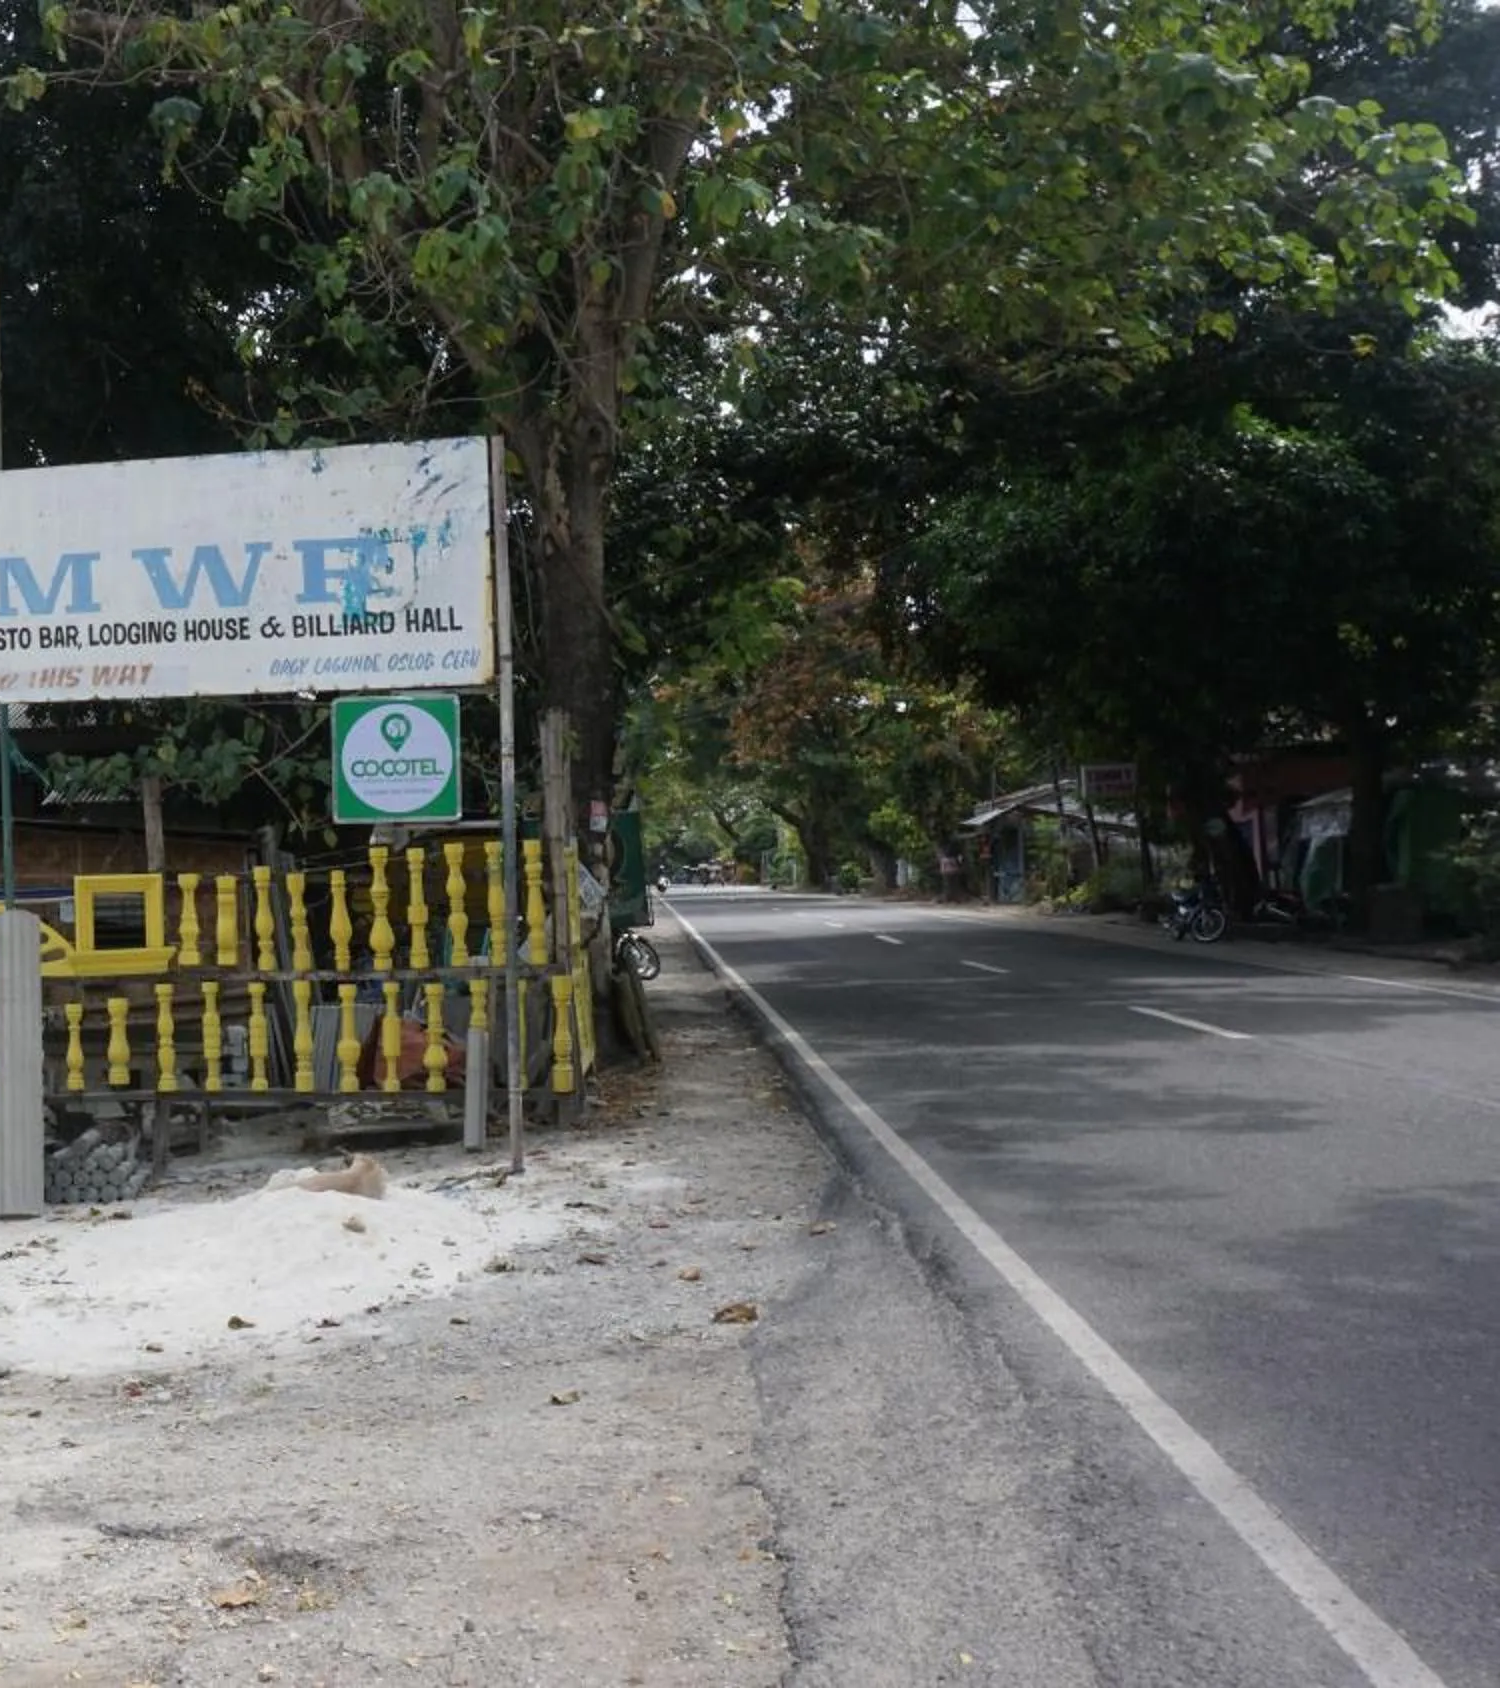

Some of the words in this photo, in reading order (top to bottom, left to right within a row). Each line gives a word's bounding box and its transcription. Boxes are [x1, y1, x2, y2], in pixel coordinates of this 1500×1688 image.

[39, 624, 83, 650] BAR,
[88, 620, 177, 646] LODGING
[184, 616, 251, 641] HOUSE
[260, 615, 286, 639] &
[292, 611, 395, 638] BILLIARD
[405, 605, 463, 634] HALL
[351, 758, 445, 777] COCOTEL
